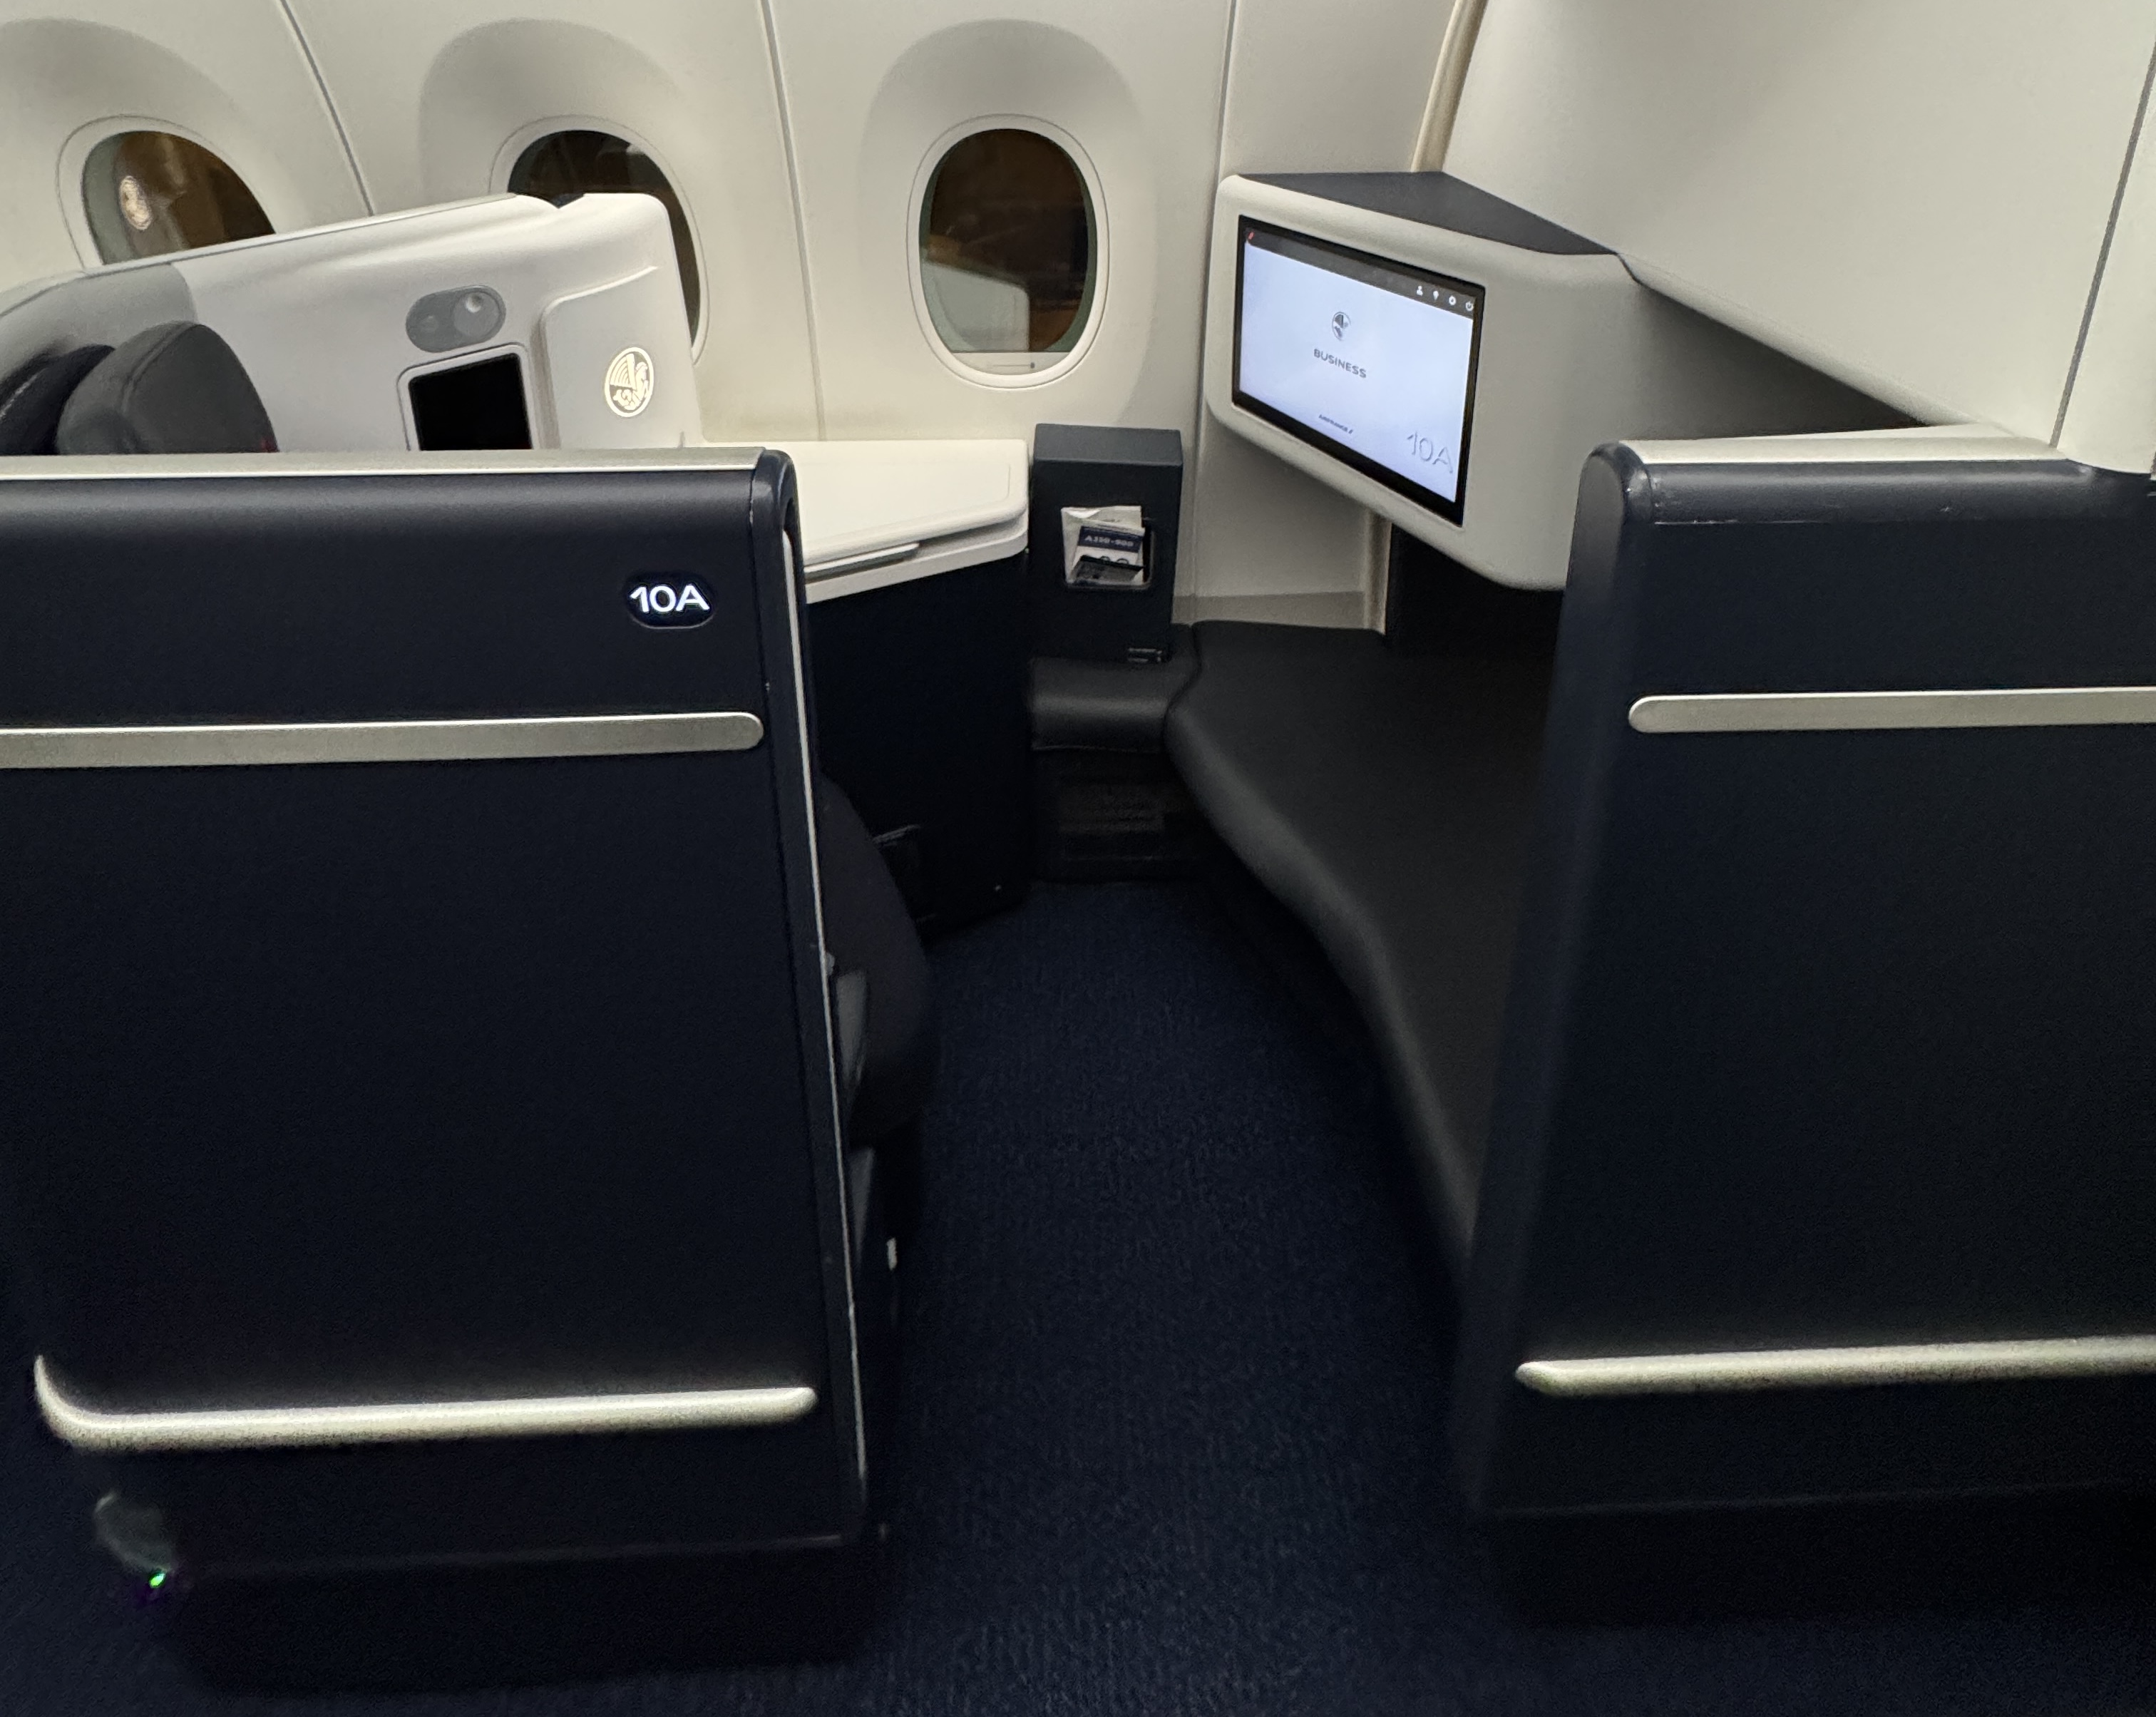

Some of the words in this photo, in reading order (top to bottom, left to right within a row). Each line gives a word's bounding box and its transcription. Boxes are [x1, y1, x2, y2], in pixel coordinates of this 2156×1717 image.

[1313, 349, 1367, 378] BUSINESS
[1407, 431, 1454, 473] 10A
[630, 583, 710, 613] 10A
